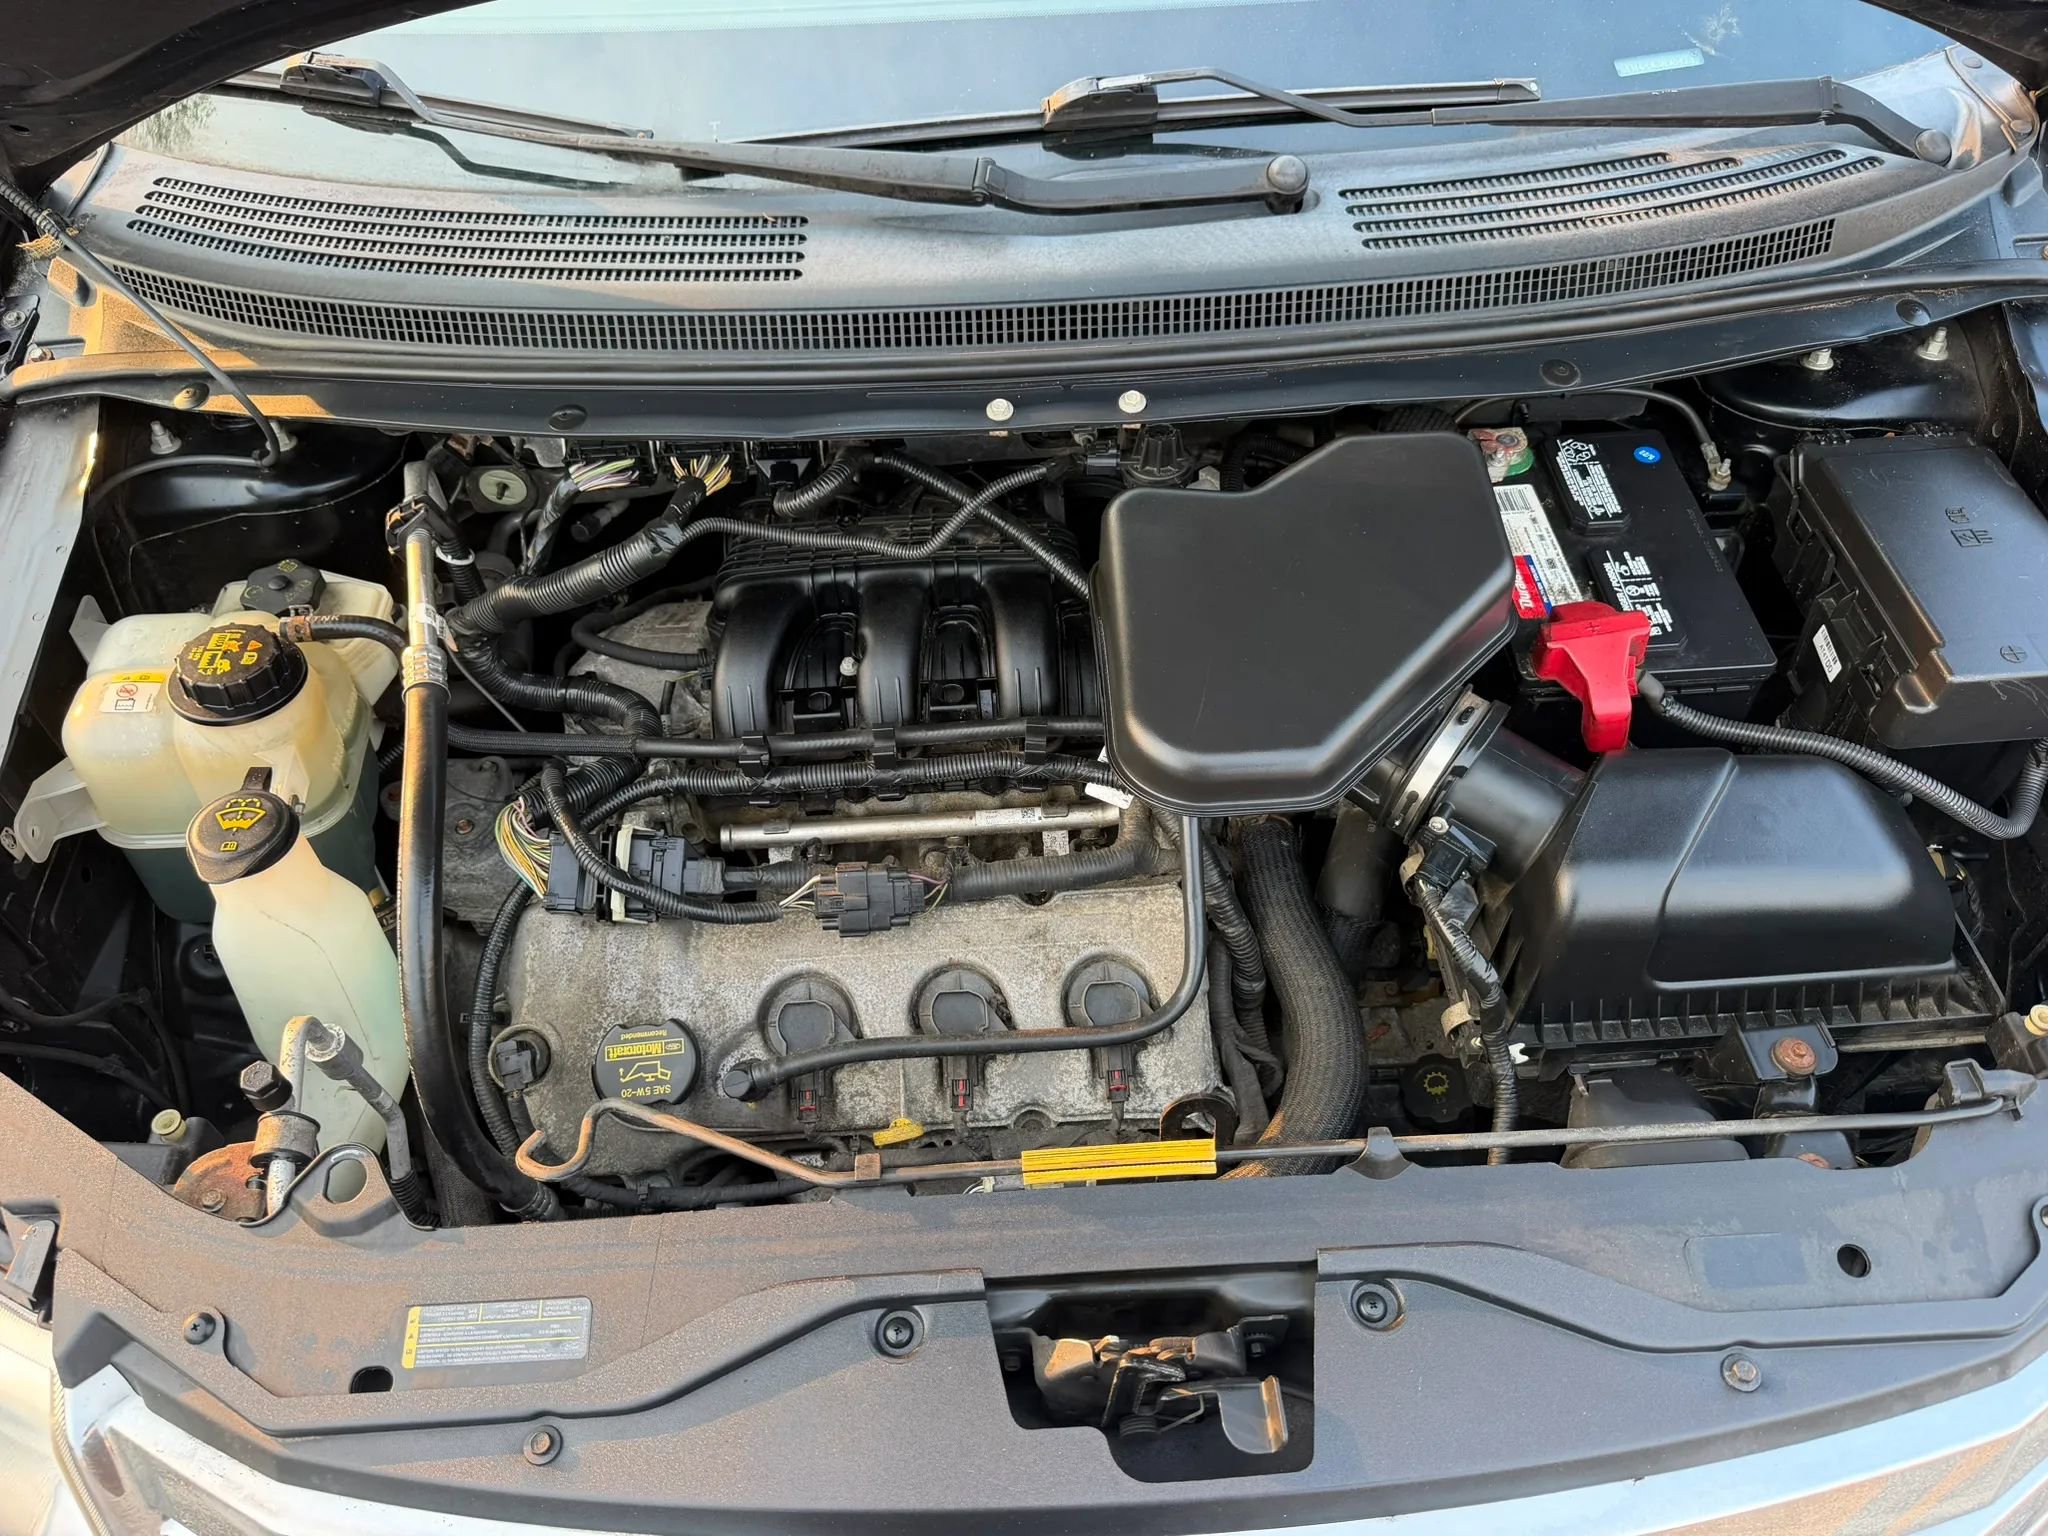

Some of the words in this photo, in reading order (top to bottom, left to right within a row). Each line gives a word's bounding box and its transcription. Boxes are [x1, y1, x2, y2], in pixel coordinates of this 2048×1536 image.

[1603, 562, 1621, 587] POISON
[1616, 592, 1631, 611] NGER
[620, 1029, 667, 1040] Recommended
[608, 1042, 661, 1059] Motorcraft
[621, 1086, 651, 1098] 5W-20
[653, 1084, 672, 1094] SAE
